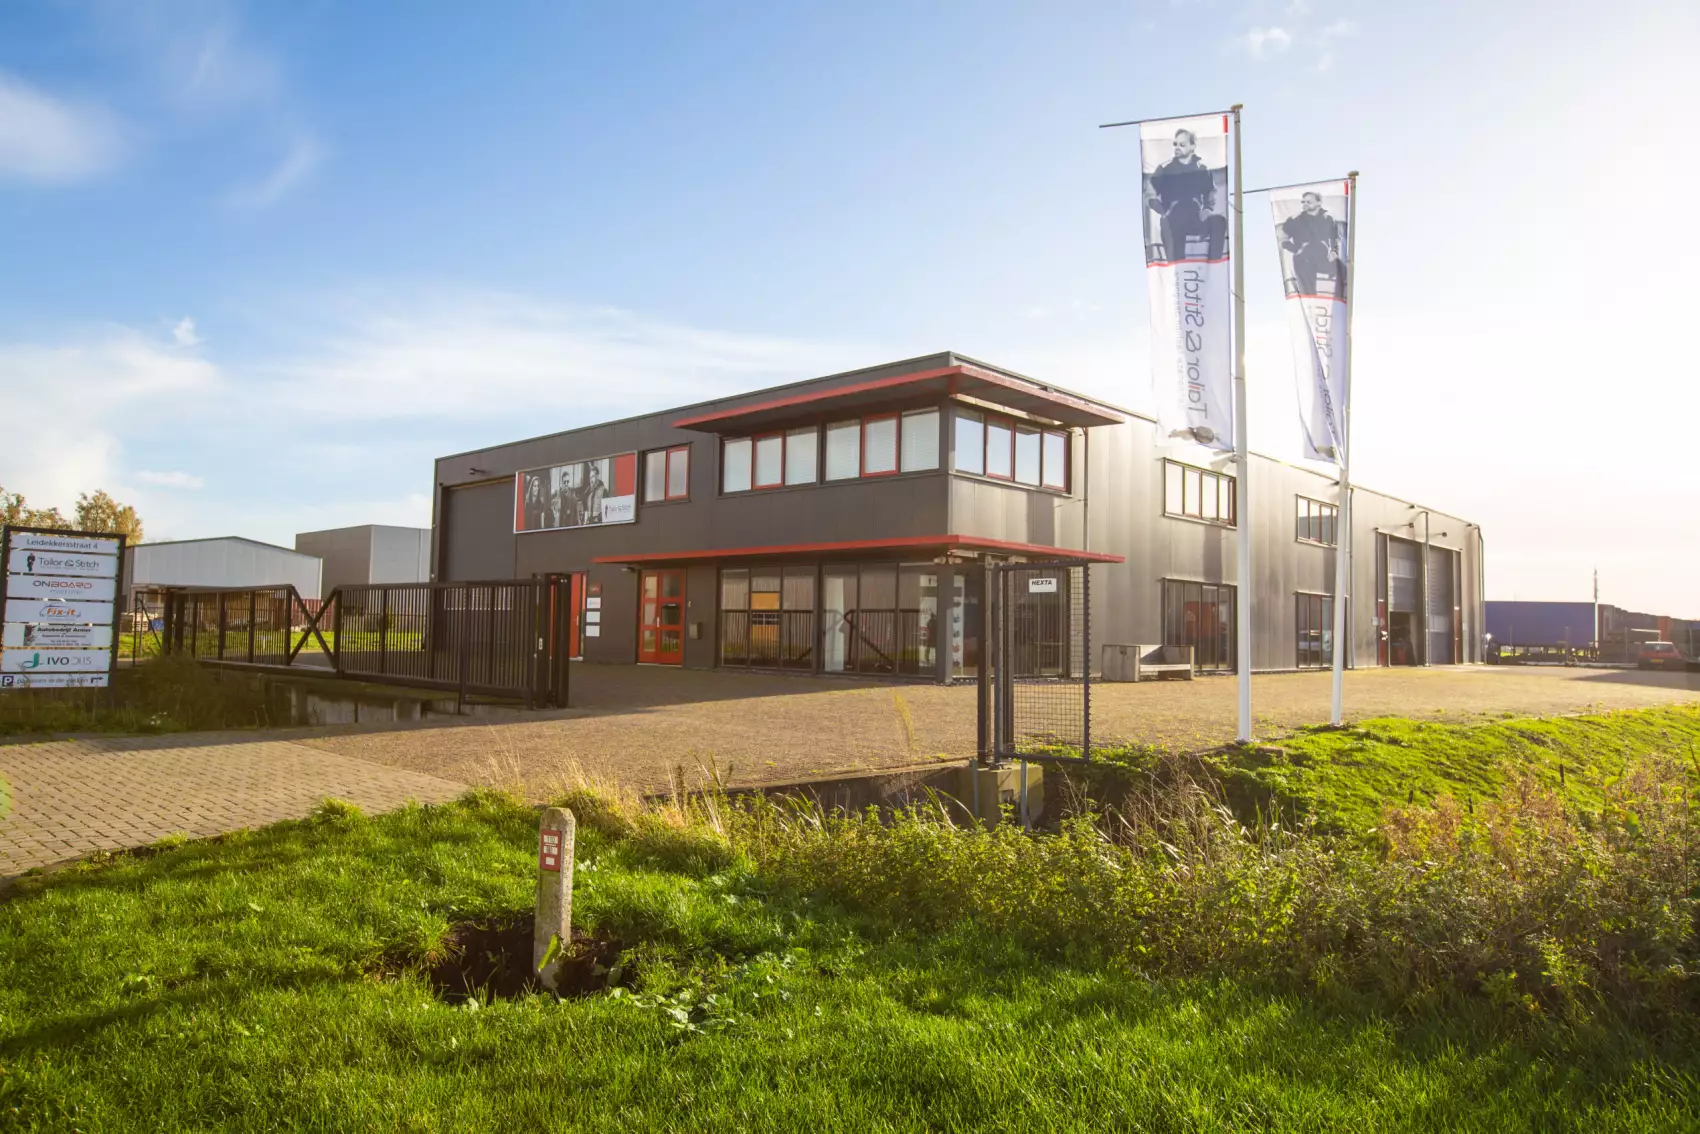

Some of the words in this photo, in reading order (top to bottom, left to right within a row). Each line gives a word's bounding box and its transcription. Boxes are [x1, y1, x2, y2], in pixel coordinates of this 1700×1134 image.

[38, 557, 62, 566] Tailor
[75, 559, 99, 568] Stitch
[32, 580, 92, 589] ONBOARD
